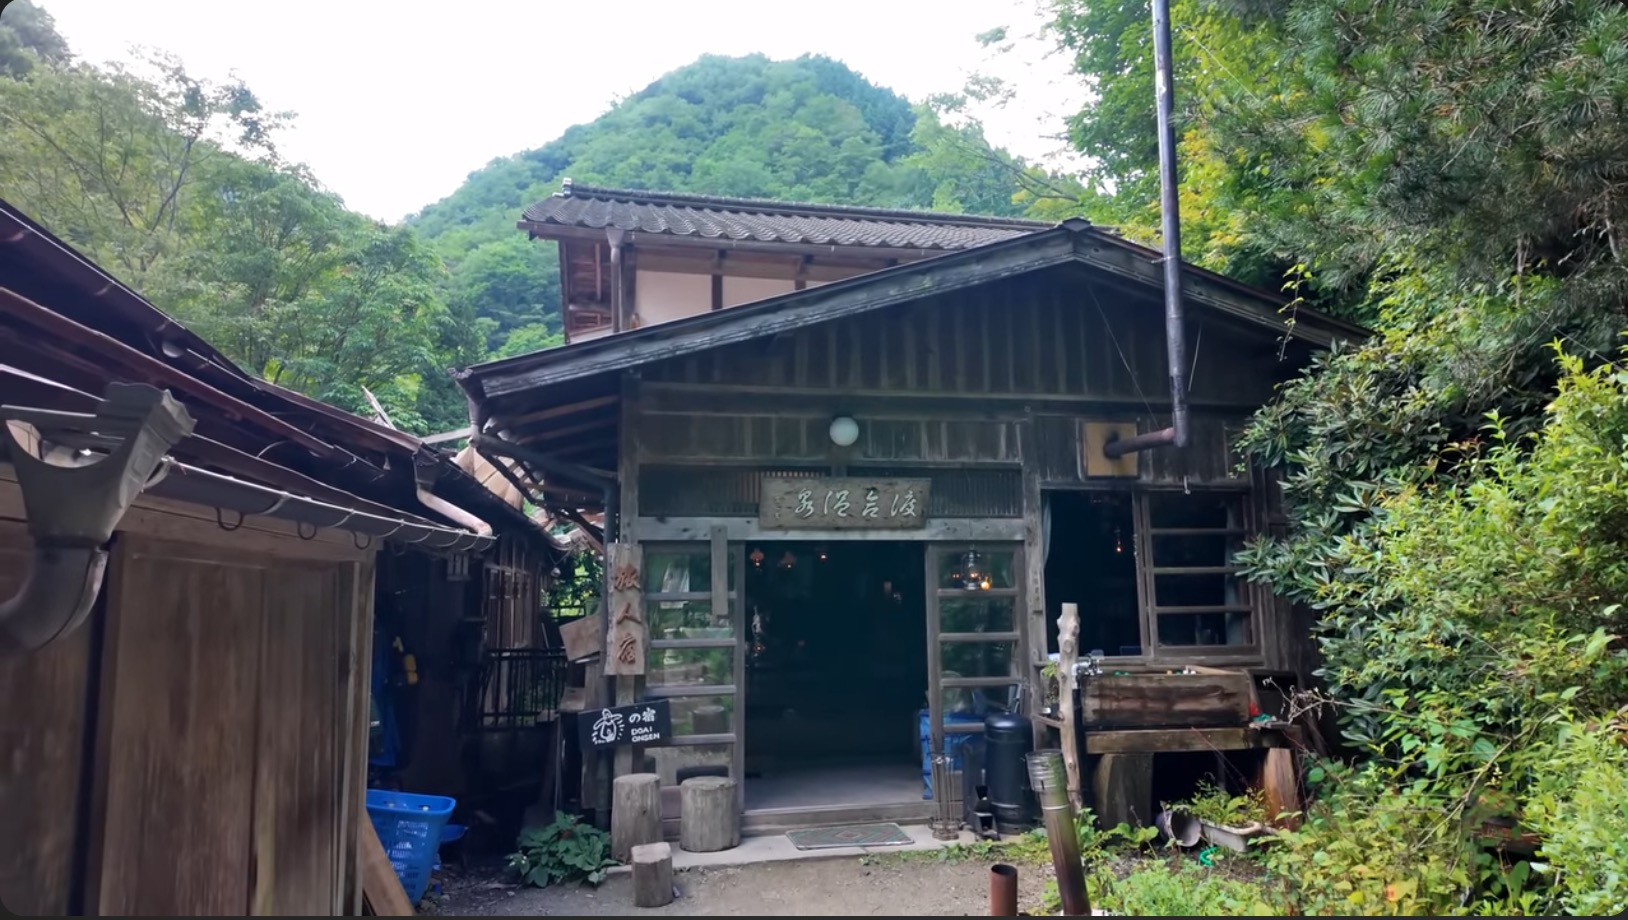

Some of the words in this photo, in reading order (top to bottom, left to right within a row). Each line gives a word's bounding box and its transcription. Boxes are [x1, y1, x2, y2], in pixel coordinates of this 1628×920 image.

[613, 563, 642, 664] 旅人宿
[628, 707, 656, 723] の宿
[630, 726, 653, 736] DOAI
[631, 732, 660, 742] ONSEN
